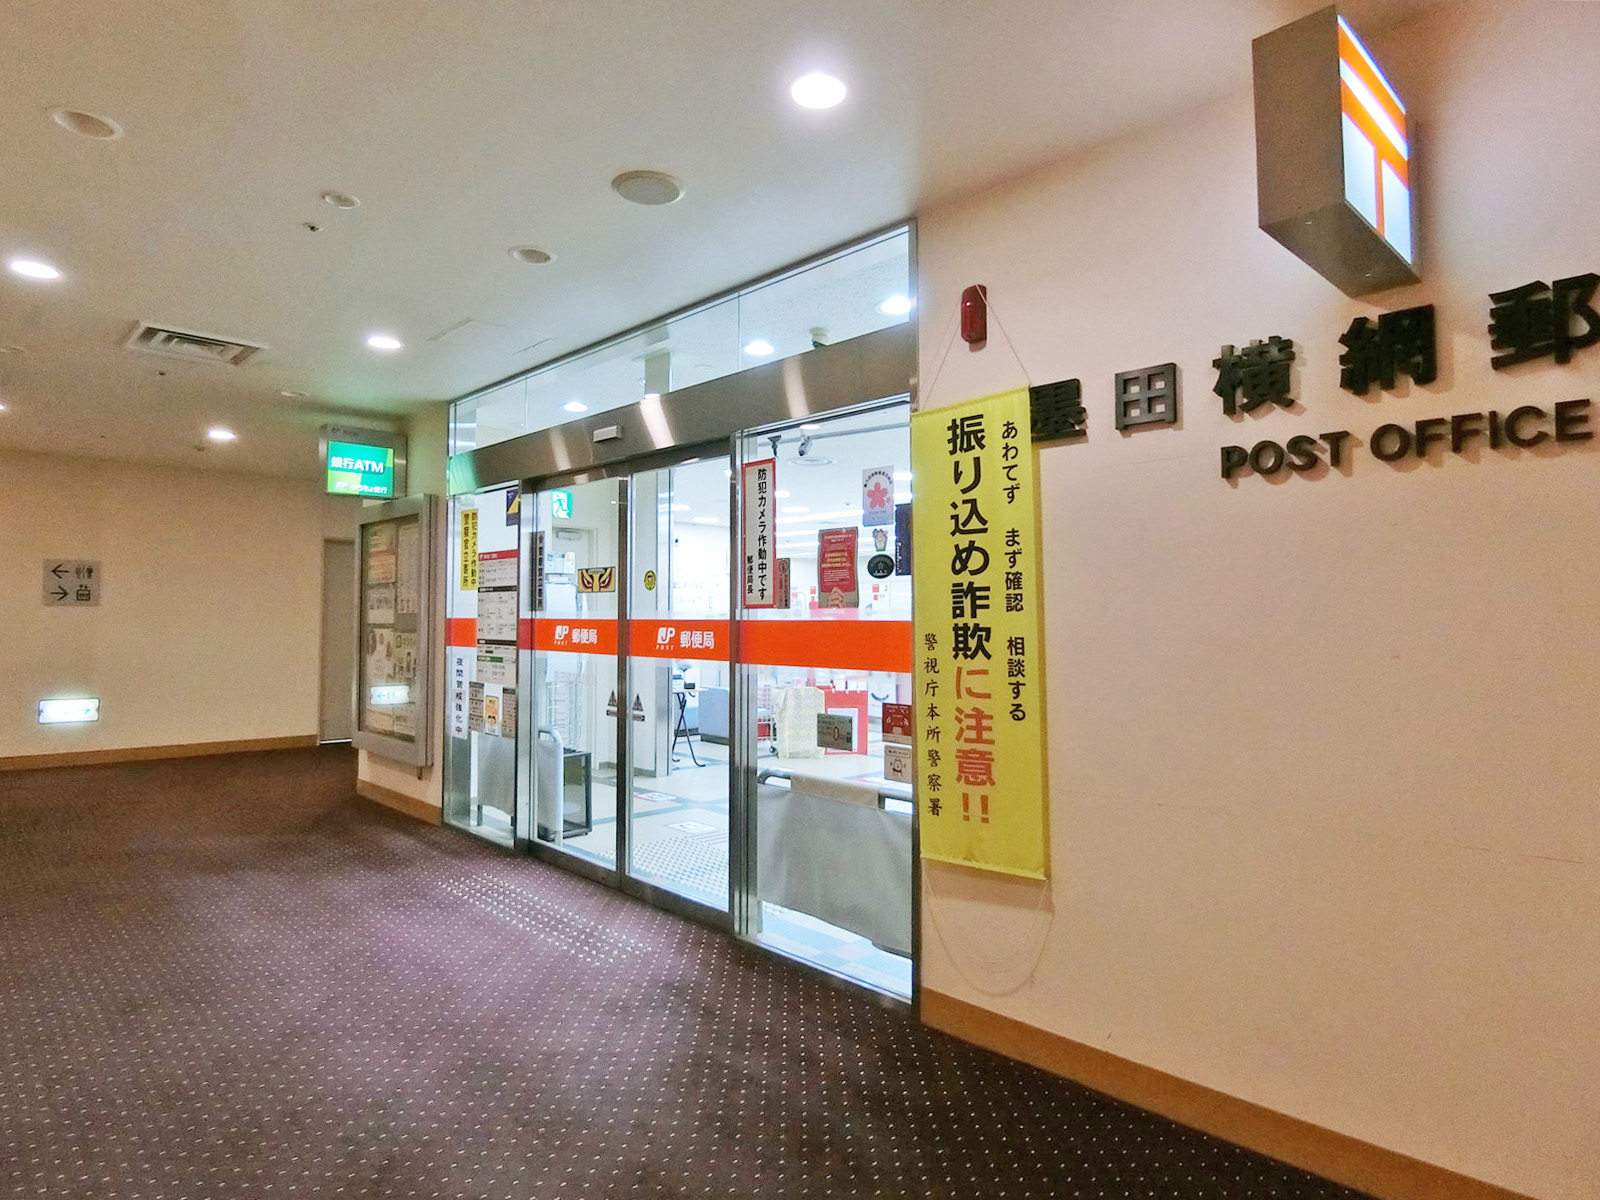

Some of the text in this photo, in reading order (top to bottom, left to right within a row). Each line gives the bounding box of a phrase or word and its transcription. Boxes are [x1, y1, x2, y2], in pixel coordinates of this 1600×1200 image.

[331, 456, 385, 473] 銀行ATM
[1220, 397, 1593, 480] POST OFFICE
[757, 468, 768, 601] 防犯カメラ作動中です
[1001, 420, 1027, 722] あわてず まず確認 相談する
[571, 628, 598, 645] 郵便局
[680, 631, 714, 650] 郵便局
[923, 632, 943, 817] 警視庁本所警察署
